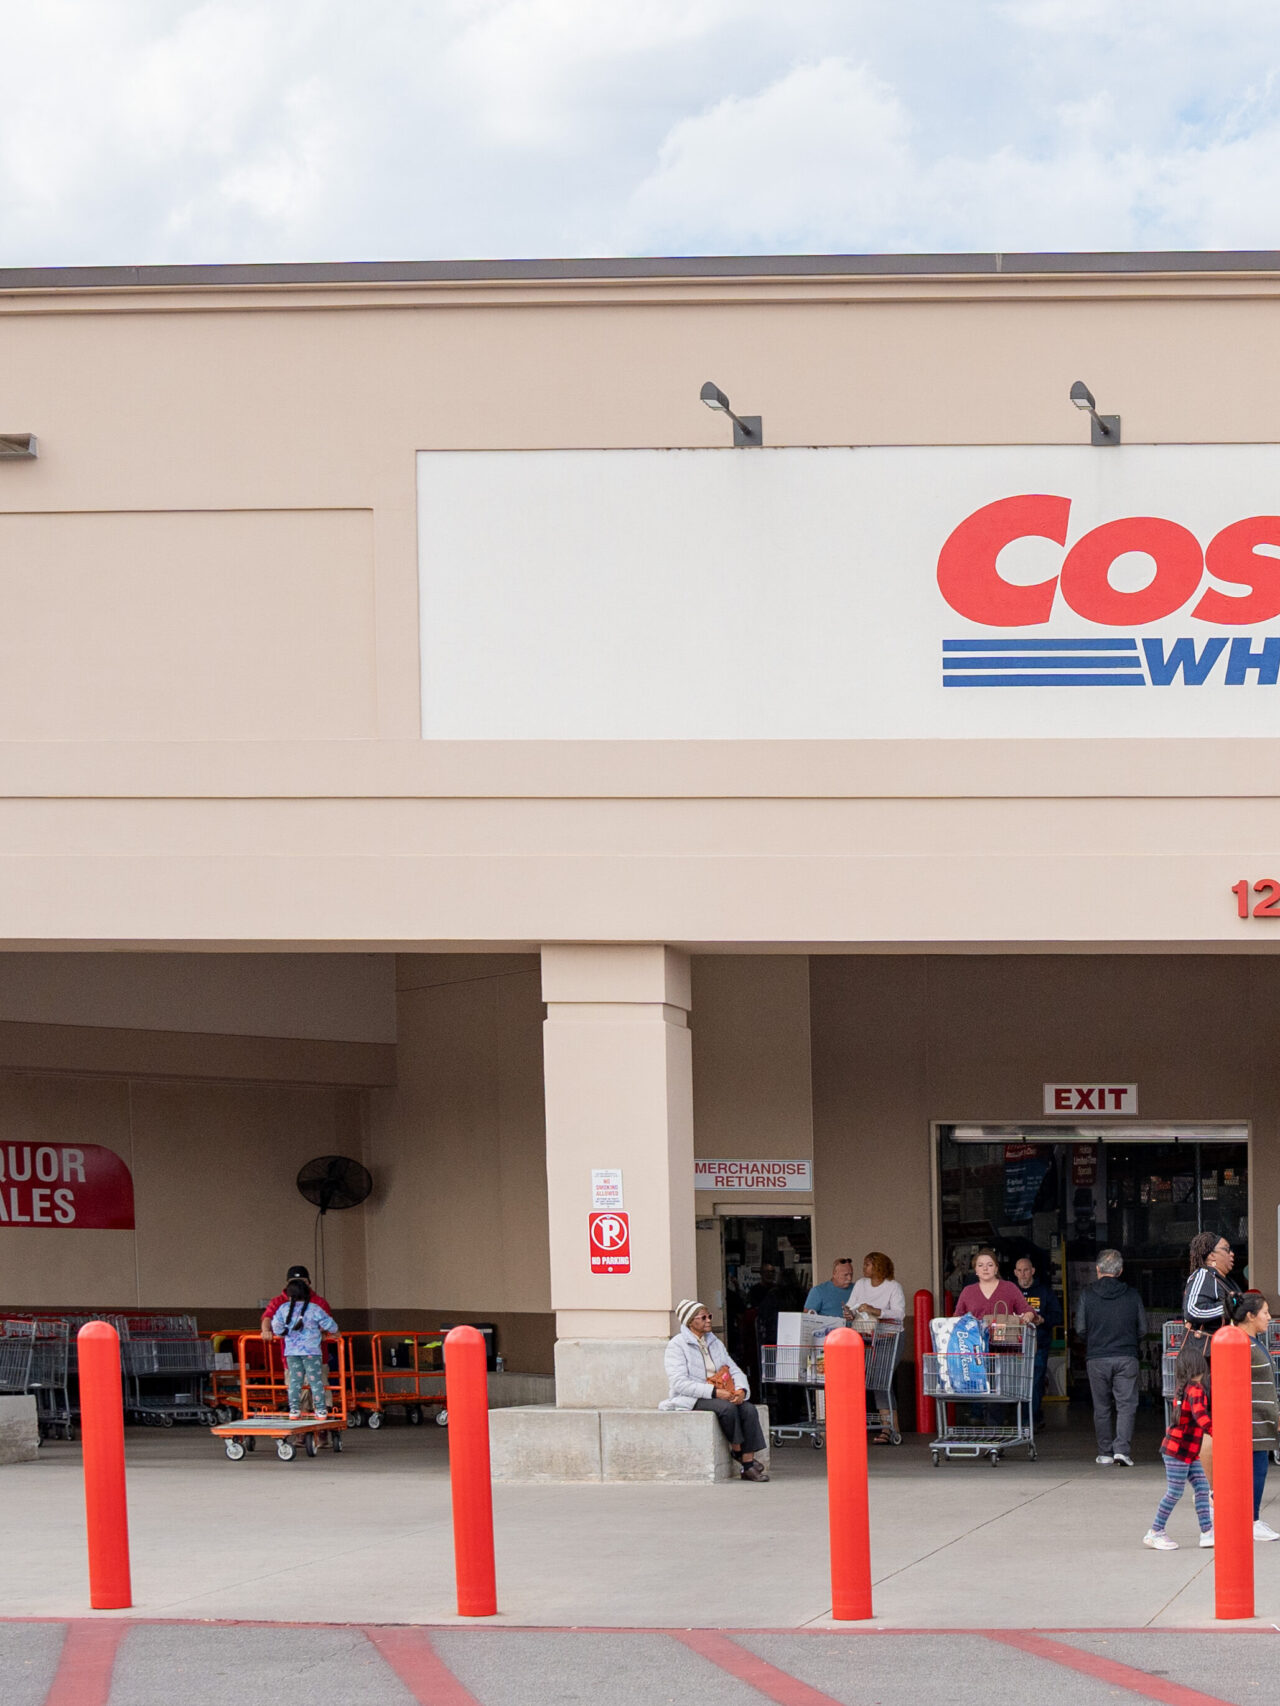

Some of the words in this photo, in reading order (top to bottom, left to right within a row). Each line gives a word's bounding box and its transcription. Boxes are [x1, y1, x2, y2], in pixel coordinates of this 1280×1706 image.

[1054, 1088, 1128, 1110] EXIT
[694, 1162, 806, 1174] MERCHANDISE
[714, 1176, 787, 1188] RETURNS
[592, 1256, 600, 1265] NO
[602, 1256, 629, 1265] PARKING
